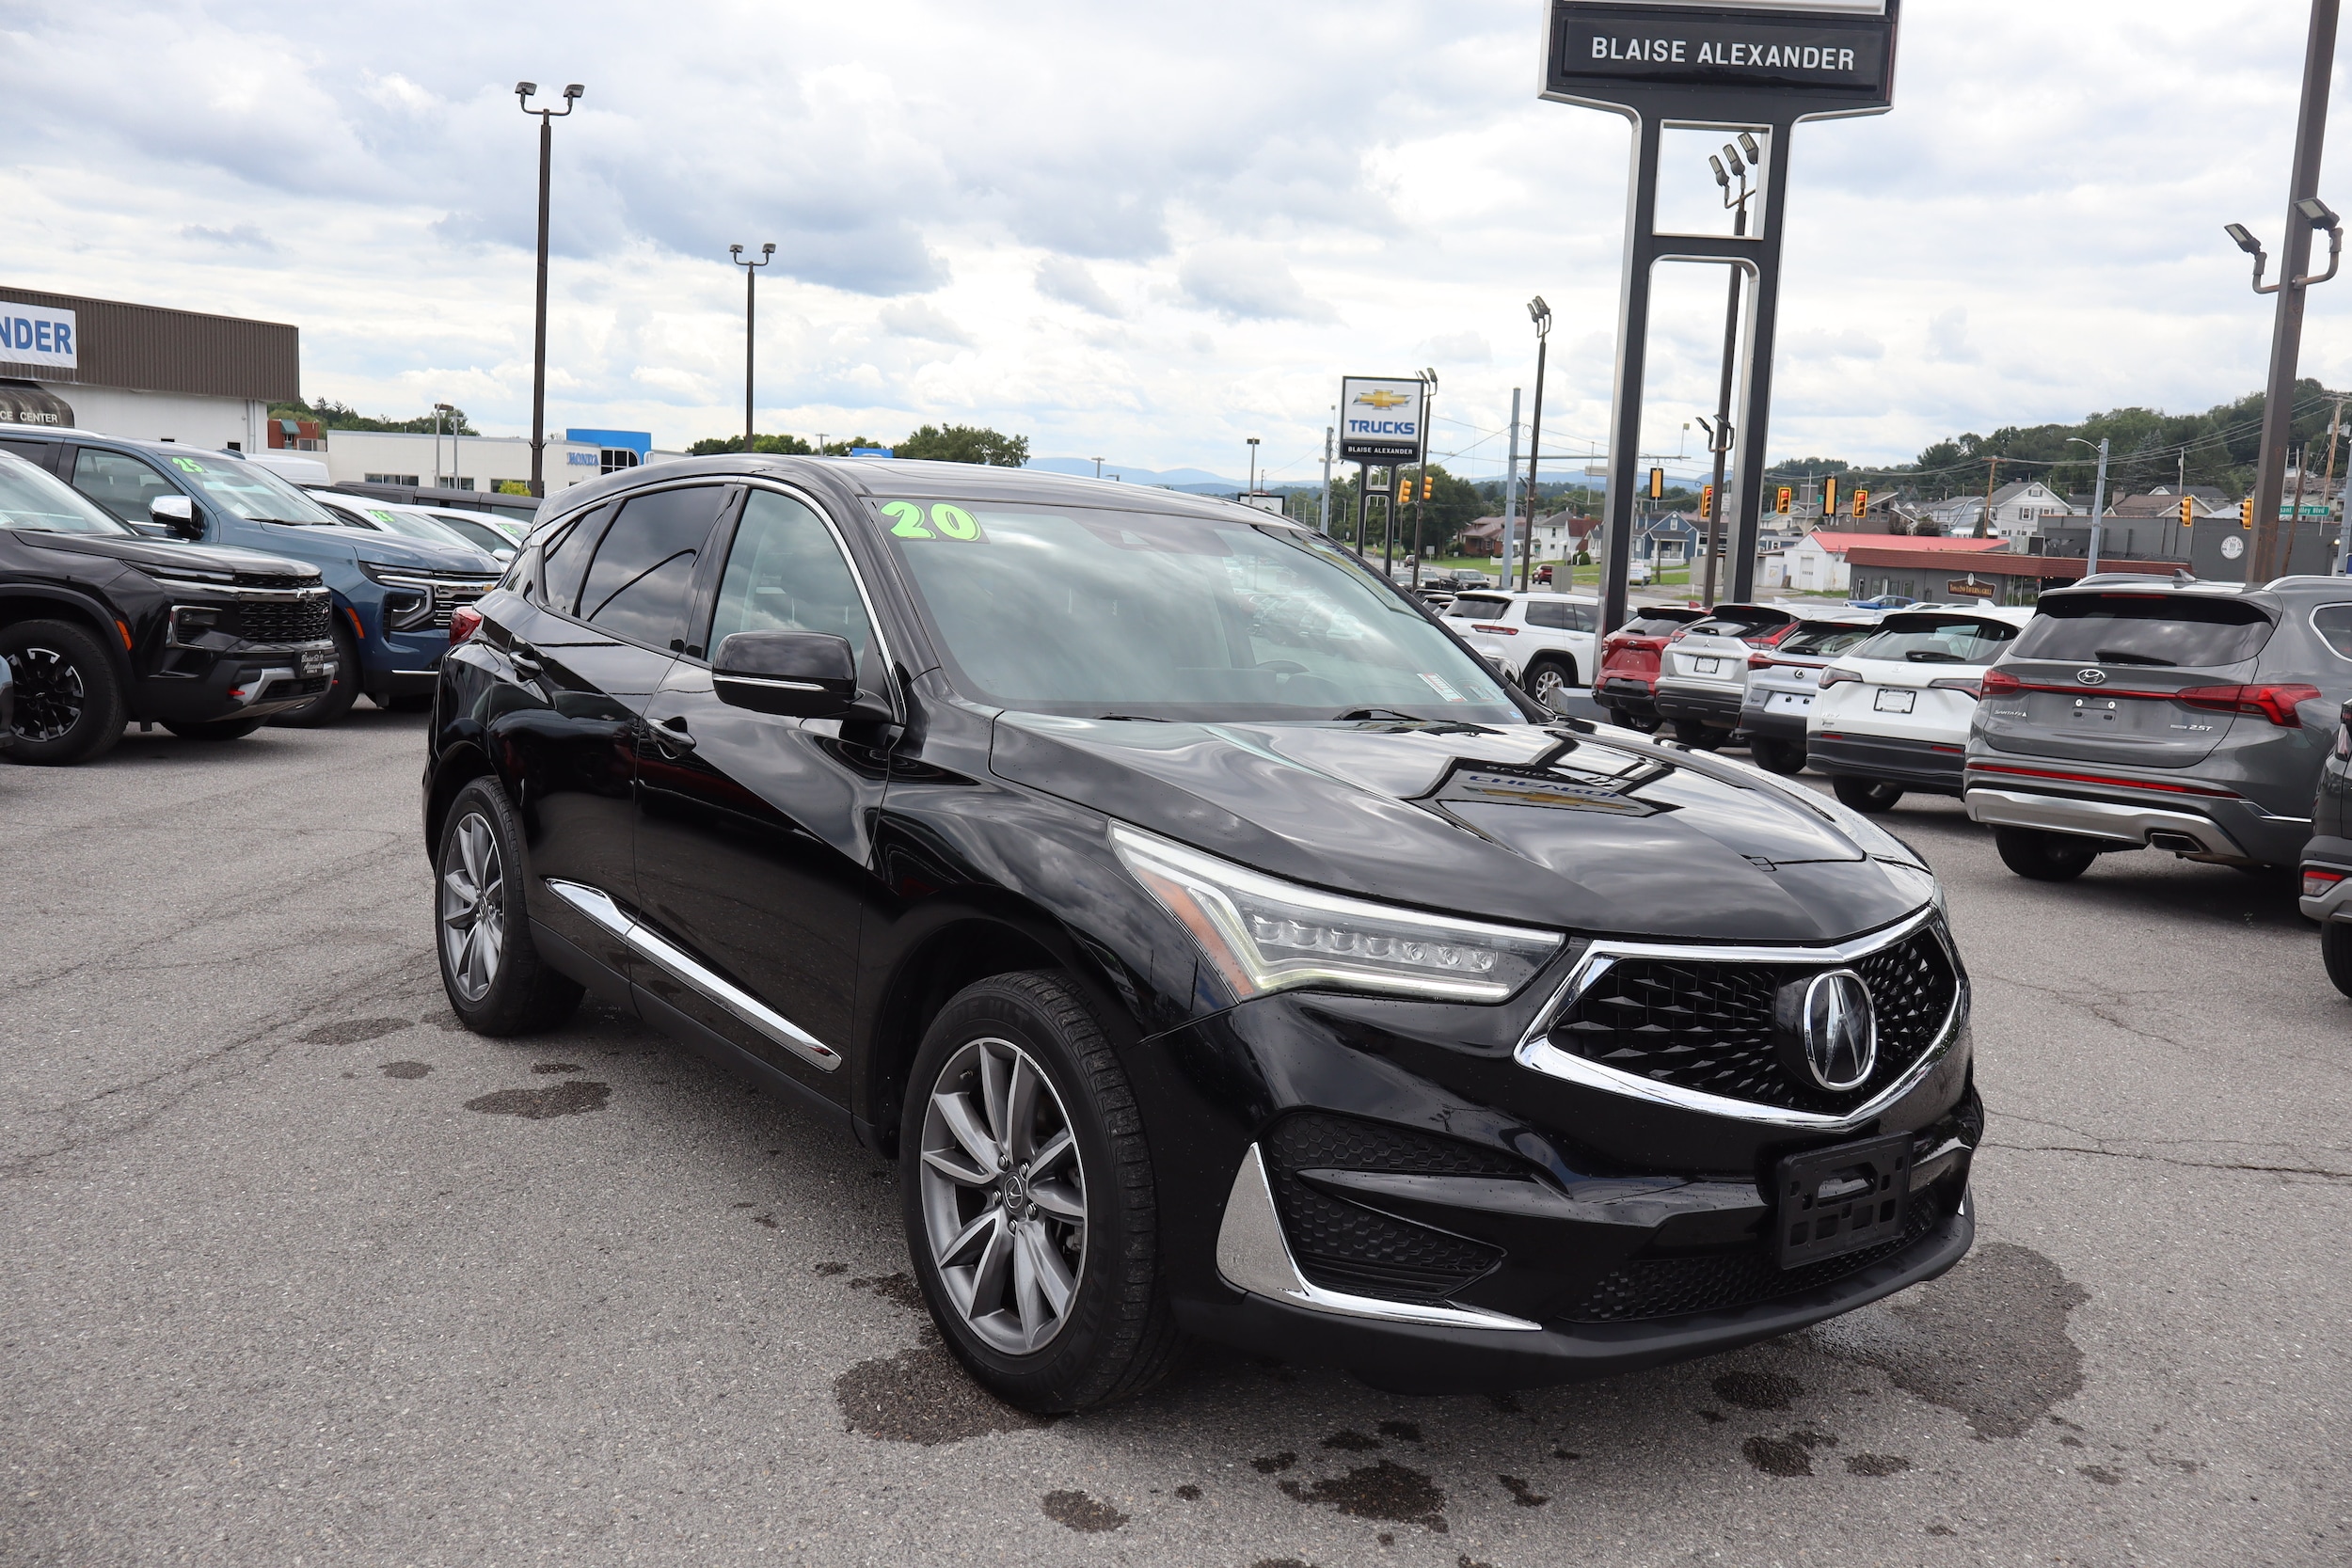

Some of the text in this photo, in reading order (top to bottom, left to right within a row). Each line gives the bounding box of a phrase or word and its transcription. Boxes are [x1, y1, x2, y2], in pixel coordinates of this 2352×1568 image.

[1591, 36, 1855, 71] BLAISE ALEXANDER
[0, 316, 73, 355] NDER
[20, 411, 58, 423] CENTER
[1348, 420, 1415, 435] TRUCKS
[1374, 447, 1413, 455] ALEXANDER
[171, 457, 204, 473] 25
[566, 452, 599, 467] HONDA
[881, 500, 981, 542] 20
